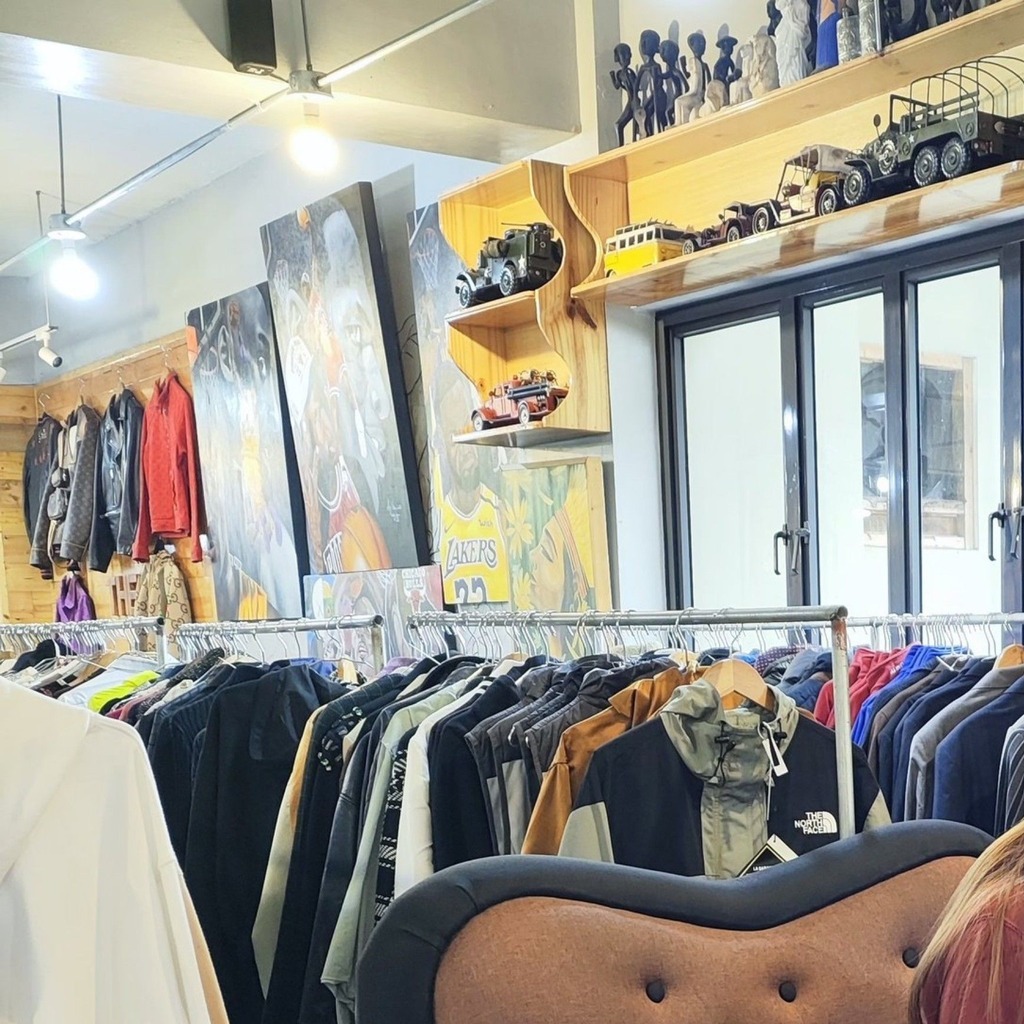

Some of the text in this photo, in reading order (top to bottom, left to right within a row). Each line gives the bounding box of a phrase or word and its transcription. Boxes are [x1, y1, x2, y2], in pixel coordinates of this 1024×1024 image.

[444, 537, 498, 579] LAKERS
[805, 812, 823, 820] THE
[794, 820, 823, 829] NORTH
[803, 827, 824, 835] FACE
